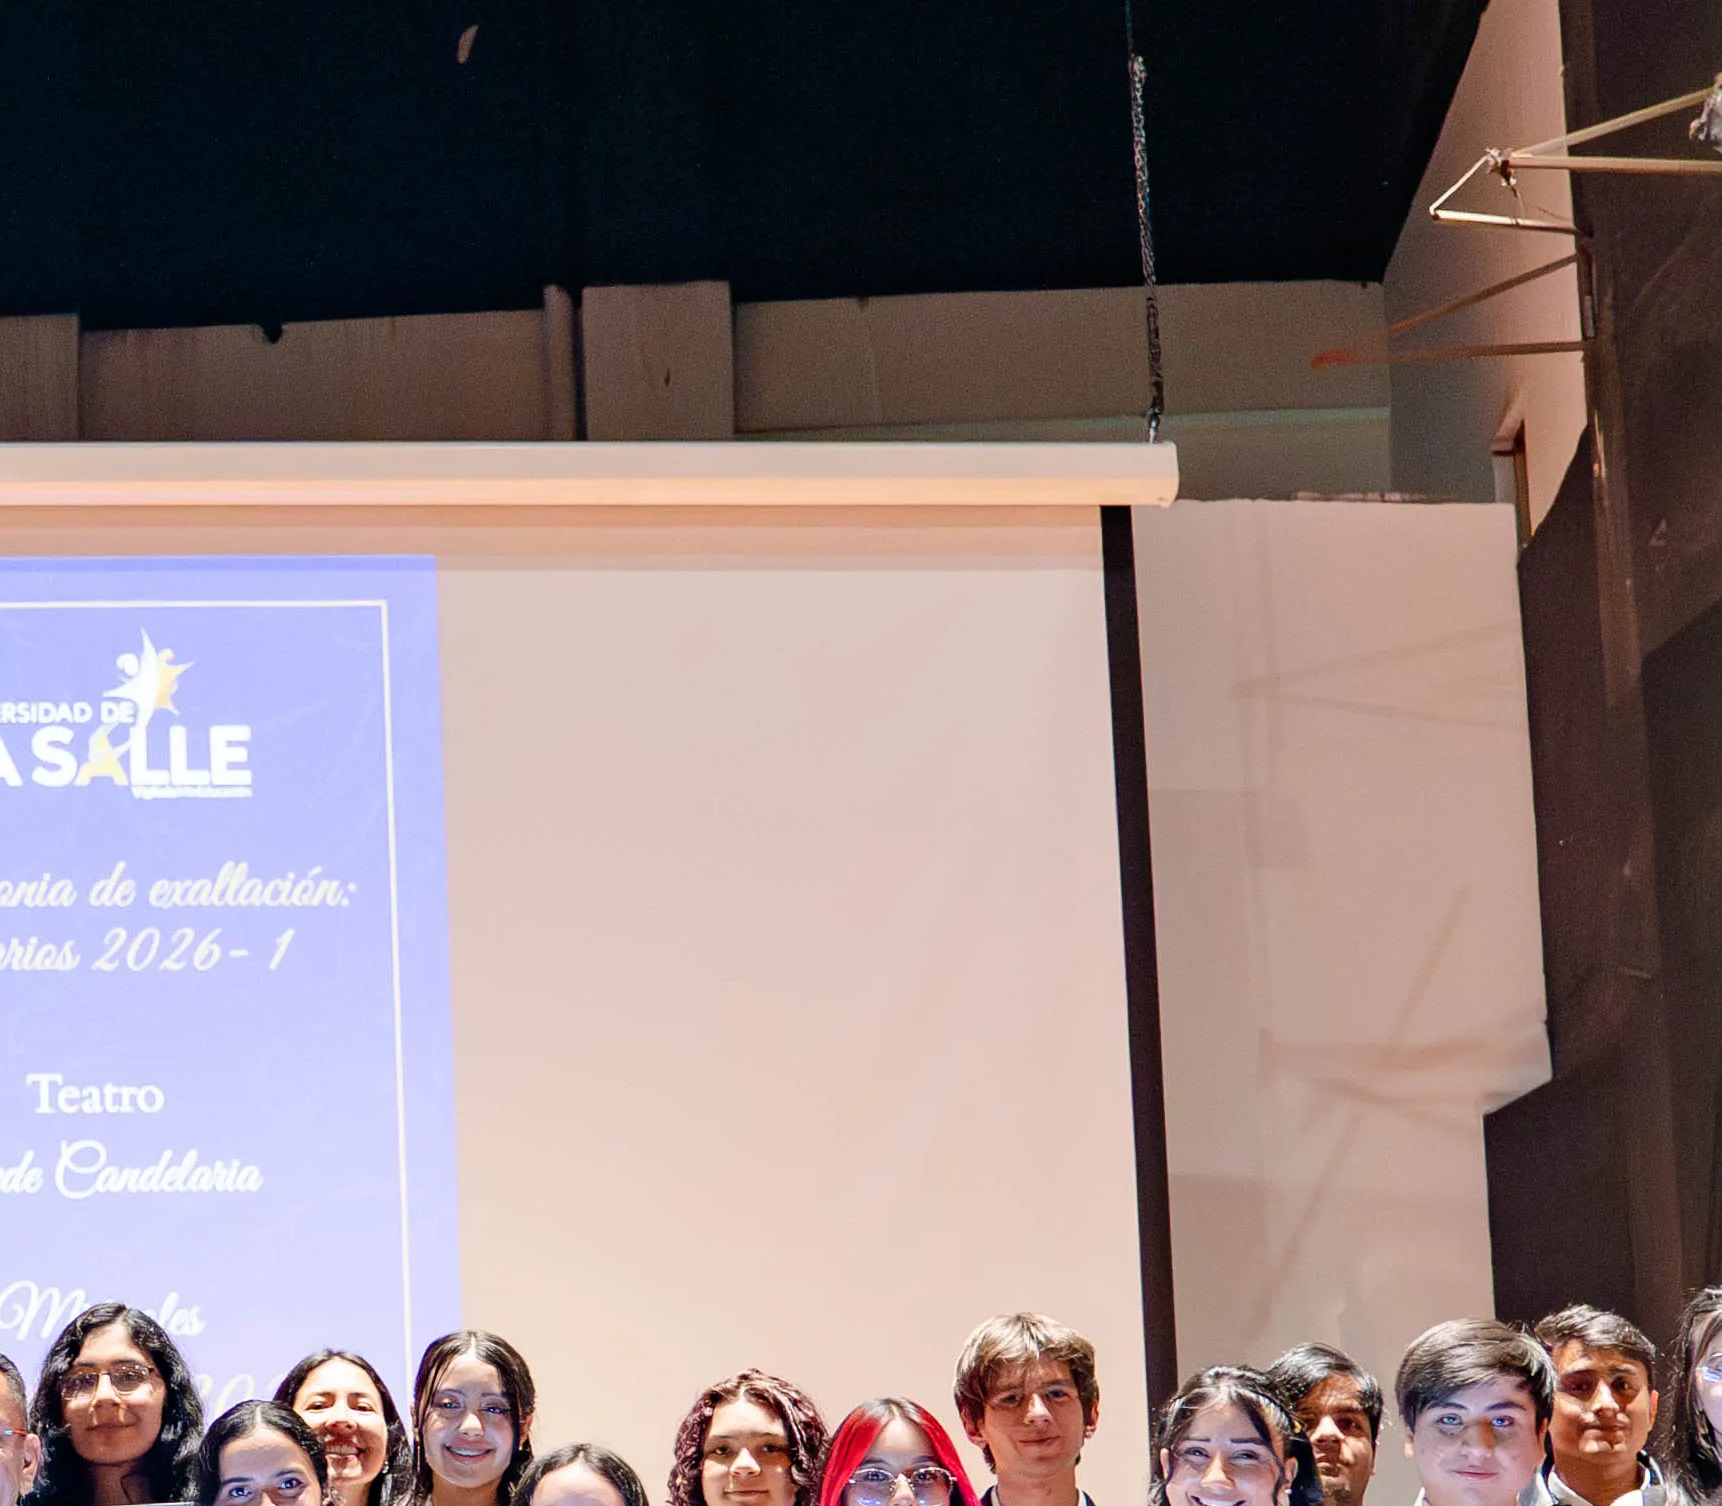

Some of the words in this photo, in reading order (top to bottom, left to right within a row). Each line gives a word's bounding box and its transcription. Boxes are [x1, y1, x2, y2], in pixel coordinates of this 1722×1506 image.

[100, 701, 134, 724] DE
[31, 724, 252, 787] SALLE
[88, 860, 135, 909] de
[25, 1072, 165, 1114] Teatro
[55, 1139, 265, 1200] Candelaria
